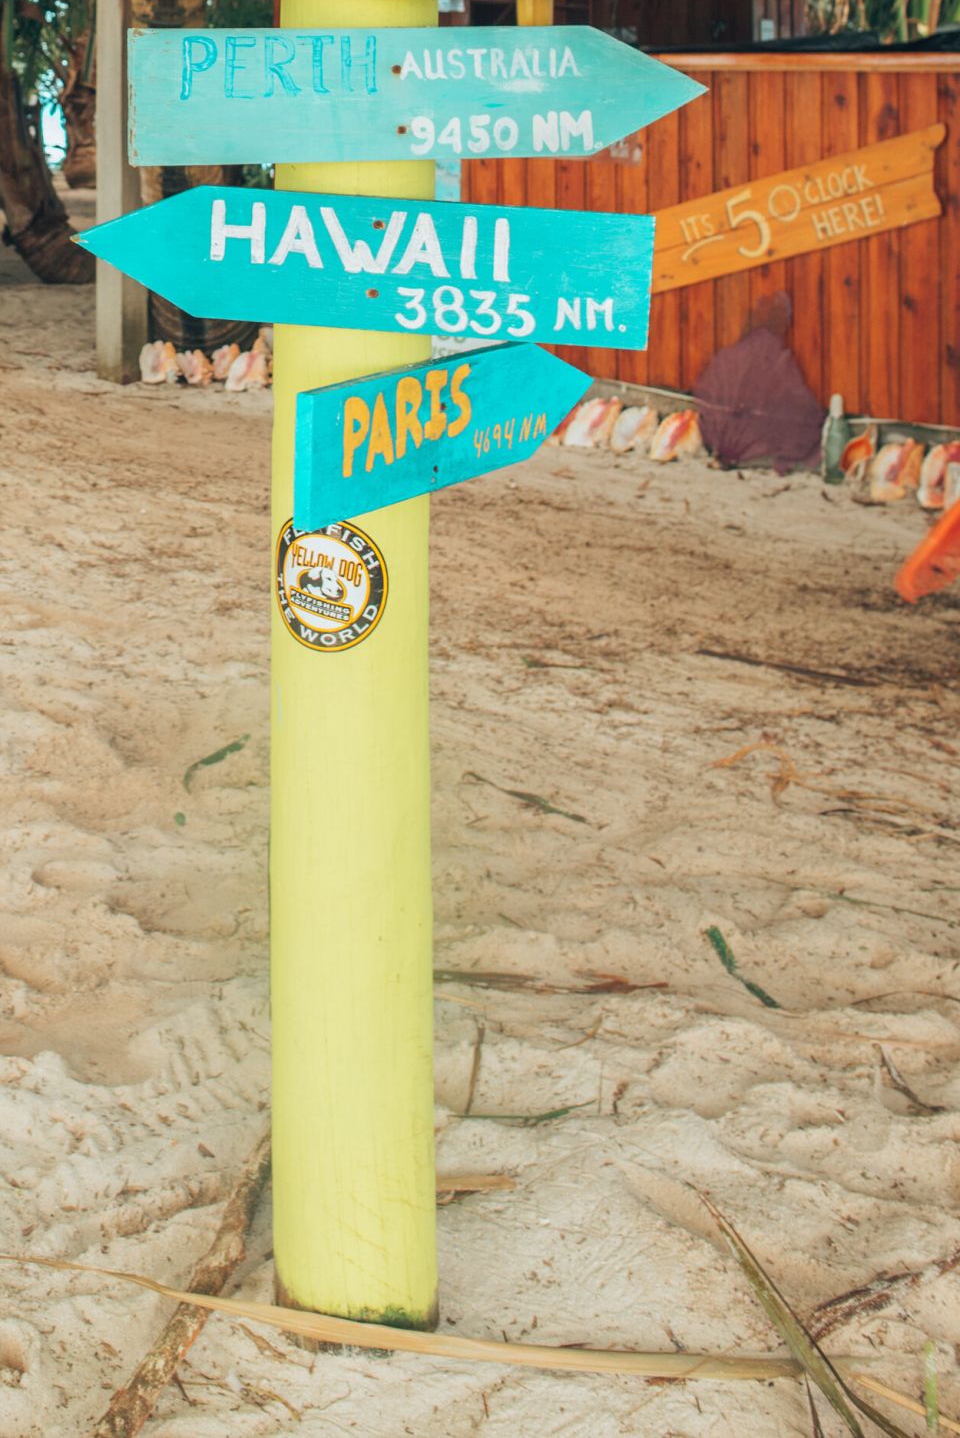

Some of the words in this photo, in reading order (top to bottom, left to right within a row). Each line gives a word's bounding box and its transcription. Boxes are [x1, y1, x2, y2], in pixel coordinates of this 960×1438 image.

[179, 35, 378, 101] PERTH
[399, 46, 584, 81] AUSTRALIA
[409, 113, 520, 156] 9450
[209, 199, 511, 284] HAWAII
[724, 187, 772, 259] 5
[811, 192, 885, 243] HERE!
[393, 284, 536, 337] 3835
[553, 296, 627, 332] NM.
[342, 363, 473, 478] PARIS
[473, 416, 516, 459] 4694
[518, 412, 547, 443] NM
[291, 543, 336, 570] YELLOW
[339, 558, 364, 588] DOG
[325, 523, 381, 571] FISH
[300, 604, 379, 646] WORLD
